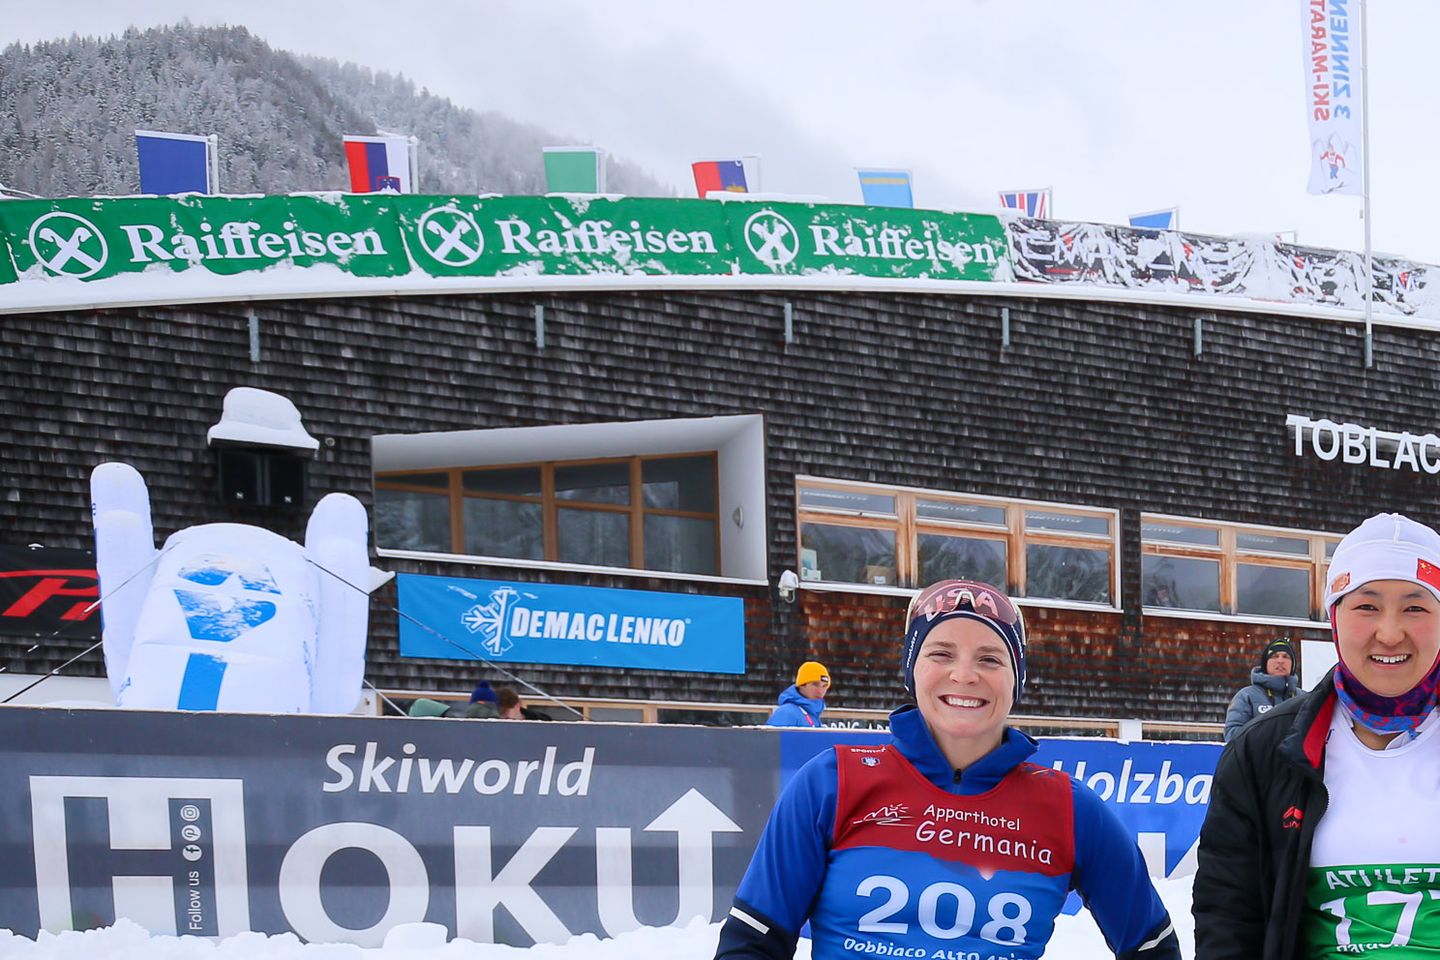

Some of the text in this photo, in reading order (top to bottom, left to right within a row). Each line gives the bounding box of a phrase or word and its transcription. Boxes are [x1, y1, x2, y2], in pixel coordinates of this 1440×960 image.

[119, 221, 388, 263] Raiffeisen
[494, 219, 718, 255] Raiffeisen
[808, 225, 997, 263] Raiffeisen
[322, 741, 597, 797] Skiworld
[1052, 759, 1214, 805] olzba
[923, 804, 1021, 831] Apparthotel
[915, 820, 1052, 865] Germania
[189, 870, 203, 931] Follow us
[855, 875, 1033, 946] 208
[843, 937, 926, 958] Dobbiaco
